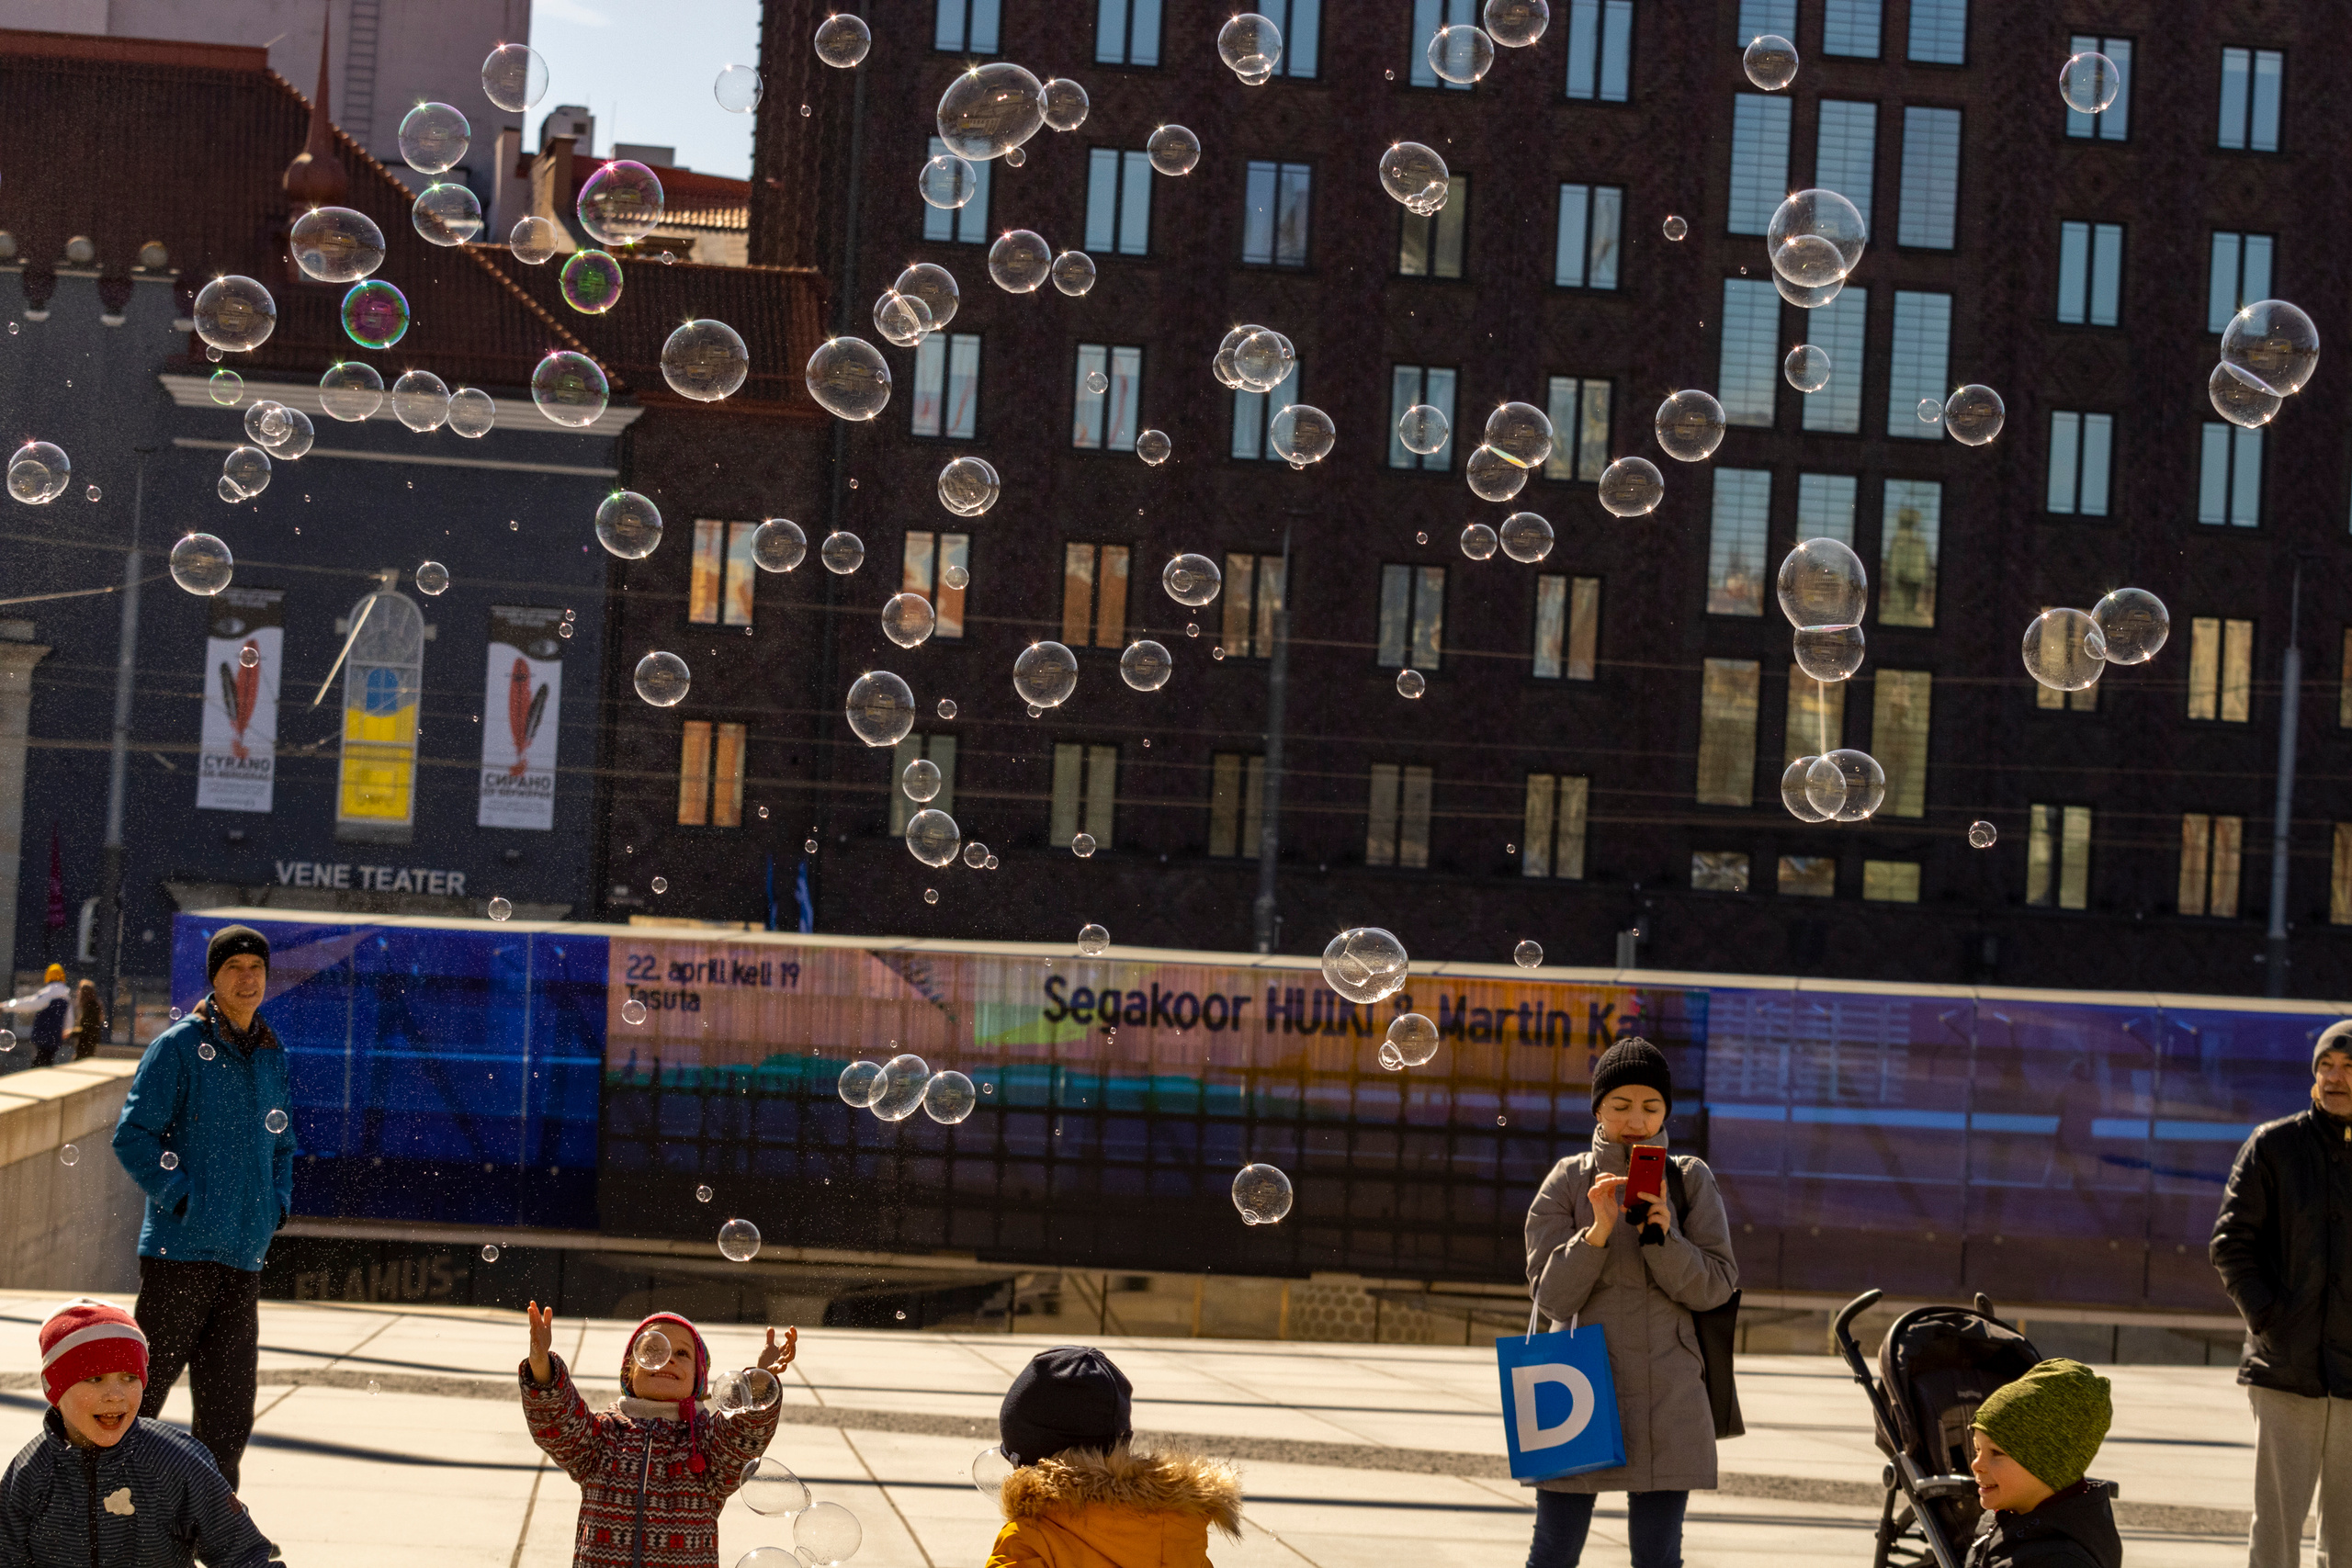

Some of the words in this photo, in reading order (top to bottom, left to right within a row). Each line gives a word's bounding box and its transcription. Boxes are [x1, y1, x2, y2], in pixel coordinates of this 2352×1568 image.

[203, 755, 271, 772] CYRANO
[277, 861, 351, 889] VENE
[357, 865, 466, 896] TEATER
[781, 961, 800, 988] 19
[626, 983, 701, 1012] Tasuta
[1044, 975, 1251, 1034] Segakoor
[1440, 994, 1572, 1047] Martin
[1511, 1363, 1595, 1453] D
